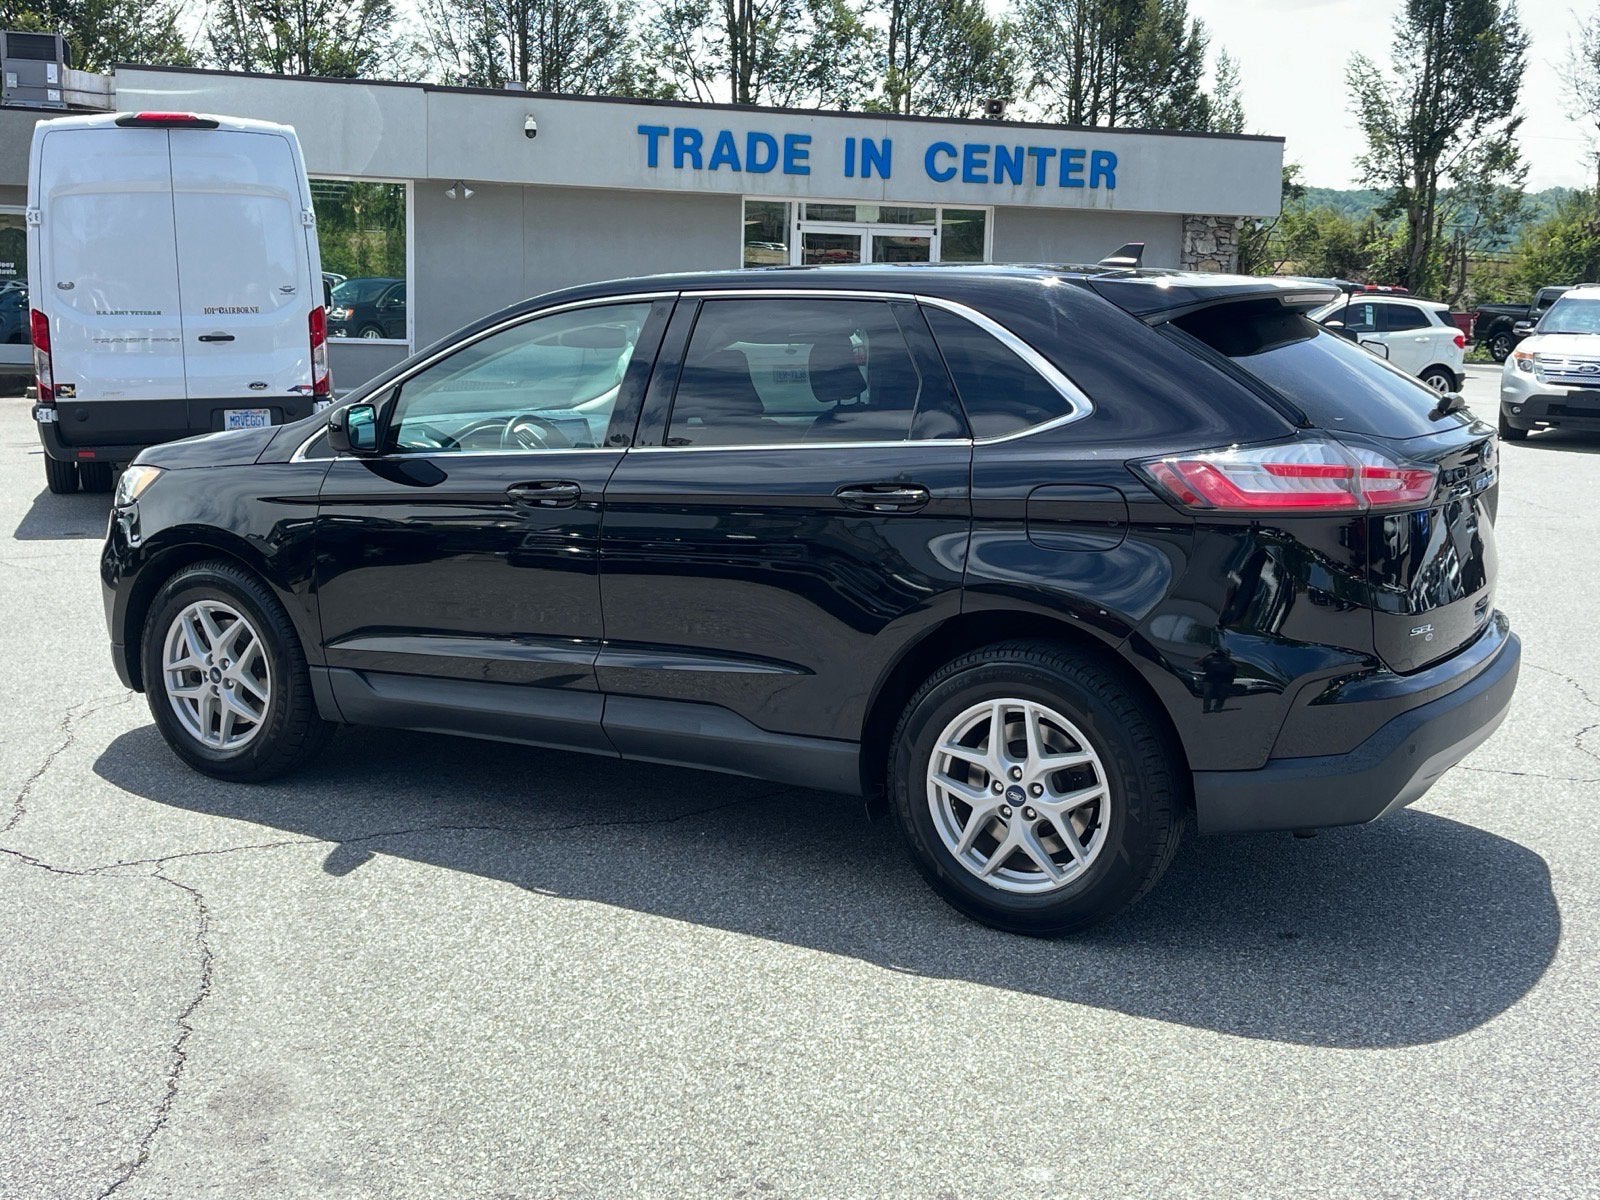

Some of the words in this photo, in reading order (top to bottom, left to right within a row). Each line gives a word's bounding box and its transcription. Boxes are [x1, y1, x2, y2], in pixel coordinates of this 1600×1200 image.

[637, 124, 812, 175] TRADE
[844, 137, 893, 179] IN
[924, 141, 1118, 189] CENTER
[223, 305, 260, 315] AIRBORNE
[229, 414, 265, 427] MRVEGGY
[1409, 624, 1434, 637] SEL
